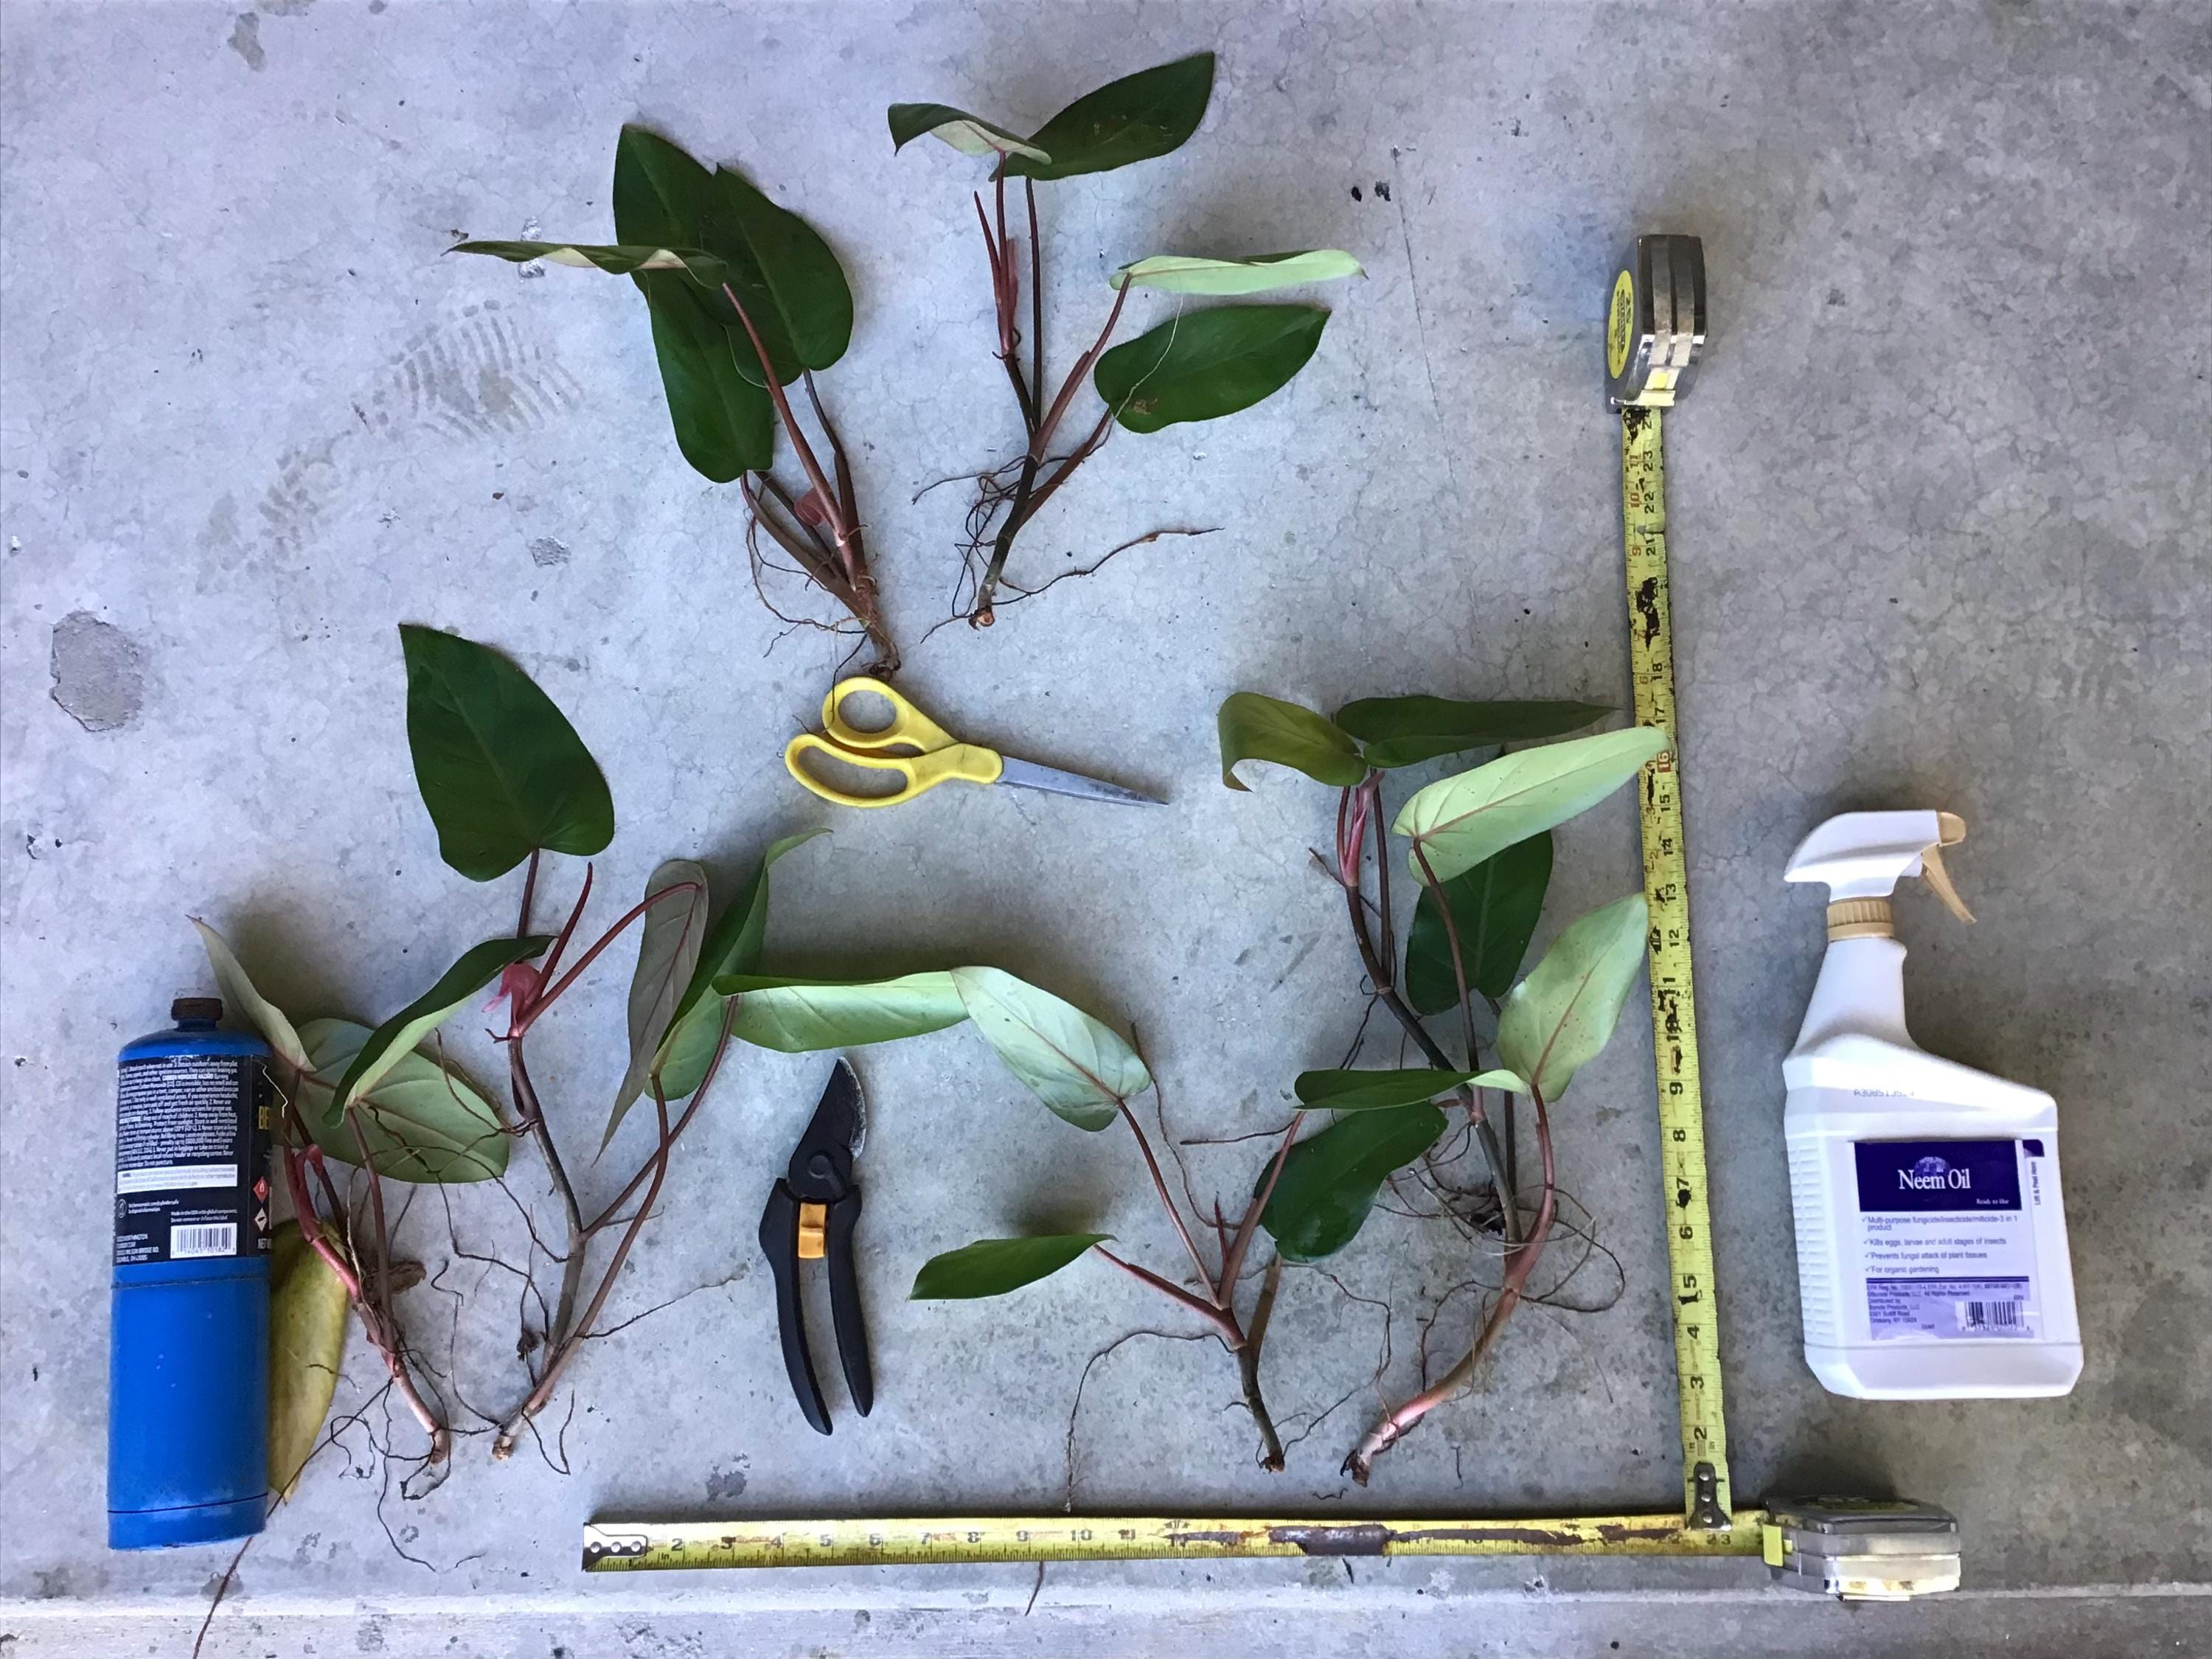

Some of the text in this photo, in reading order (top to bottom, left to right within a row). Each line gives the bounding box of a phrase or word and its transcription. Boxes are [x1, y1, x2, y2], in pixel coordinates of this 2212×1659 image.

[1643, 450, 1653, 472] 23
[1630, 492, 1641, 508] 10
[1644, 492, 1655, 514] 22
[1646, 538, 1656, 556] 21
[1652, 662, 1663, 681] 18
[1639, 675, 1649, 685] 6
[1655, 707, 1666, 724] 17
[1659, 752, 1669, 769] 16
[1659, 794, 1671, 813] 15
[1665, 883, 1677, 902] 13
[1669, 929, 1680, 947] 12
[1669, 1082, 1683, 1095] 9
[1672, 1129, 1686, 1142] 8
[1676, 1177, 1689, 1189] 7
[1897, 1168, 1972, 1189] Neem Oil
[1868, 1216, 1911, 1224] Multi-purpose
[1679, 1226, 1693, 1239] 6
[1954, 1238, 1974, 1247] stages
[1901, 1251, 1919, 1261] fungal
[1948, 1251, 1964, 1259] plant
[1884, 1266, 1907, 1275] organic
[1909, 1266, 1939, 1274] gardening
[1683, 1275, 1697, 1288] 5
[1687, 1326, 1700, 1339] 4
[1690, 1376, 1704, 1389] 3
[1694, 1427, 1708, 1440] 2
[672, 1538, 683, 1551] 2
[721, 1537, 735, 1549] 3
[771, 1537, 782, 1548] 4
[820, 1534, 832, 1547] 5
[869, 1533, 881, 1546] 6
[922, 1532, 931, 1545] 7
[967, 1531, 980, 1543] 8
[1016, 1530, 1028, 1542] 9
[1071, 1529, 1093, 1542] 10
